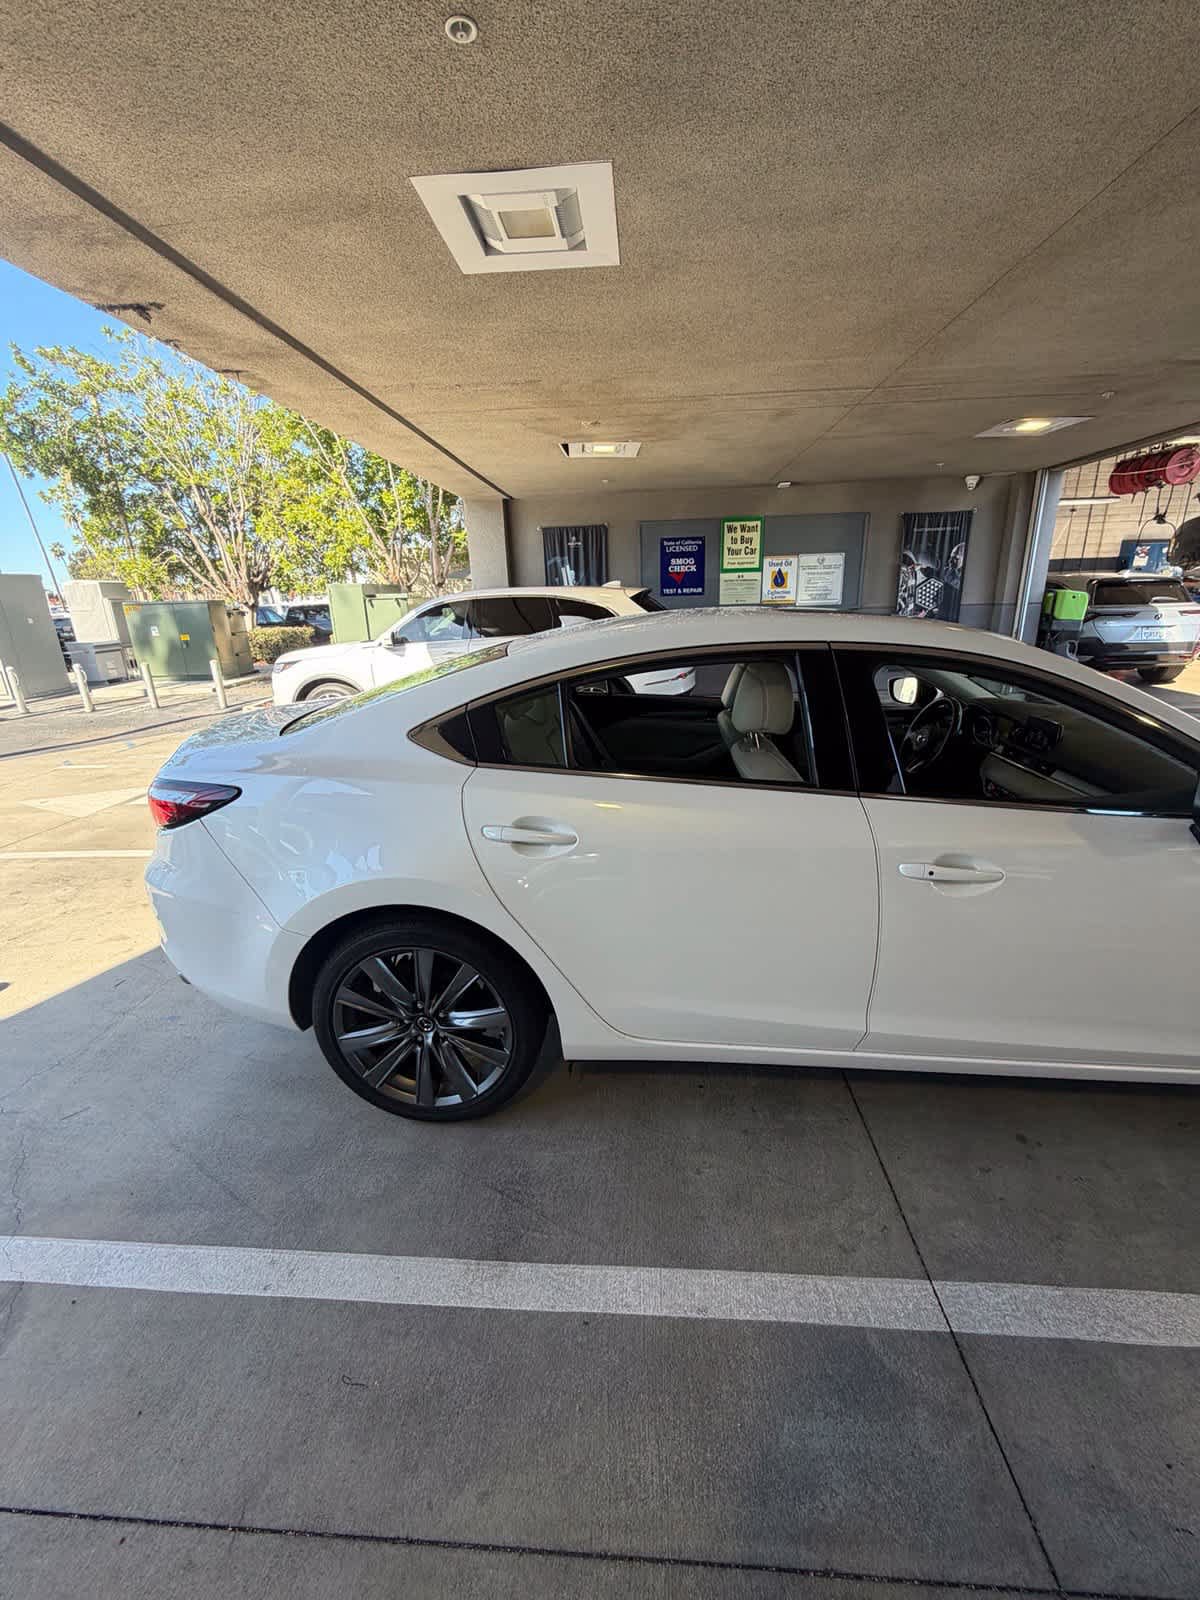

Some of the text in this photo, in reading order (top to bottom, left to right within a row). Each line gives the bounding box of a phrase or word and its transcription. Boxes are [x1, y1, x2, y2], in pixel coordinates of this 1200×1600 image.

[726, 523, 758, 534] We Want
[730, 536, 754, 546] to Buy
[726, 546, 757, 556] Your Car
[668, 564, 697, 572] CHECK
